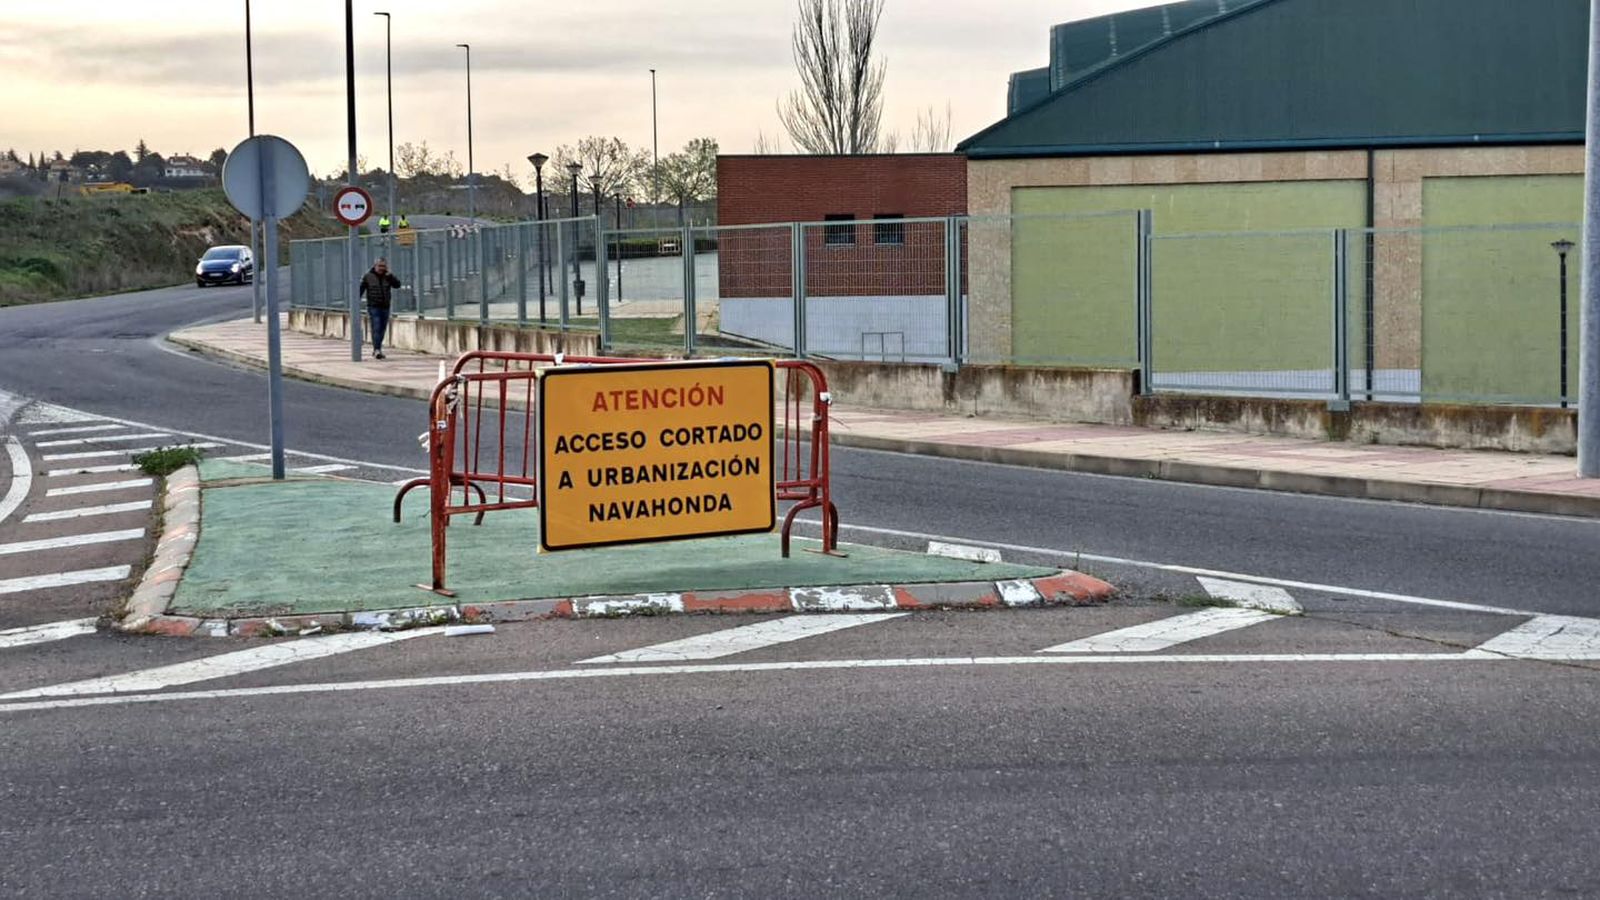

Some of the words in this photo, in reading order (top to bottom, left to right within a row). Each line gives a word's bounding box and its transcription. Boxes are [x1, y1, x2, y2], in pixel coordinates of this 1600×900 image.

[592, 382, 725, 412] ATENCIÓN
[554, 430, 647, 455] ACCESO
[659, 422, 763, 447] CORTADO
[558, 470, 574, 490] A
[587, 454, 760, 487] URBANIZACIÓN
[589, 493, 732, 523] NAVAHONDA
